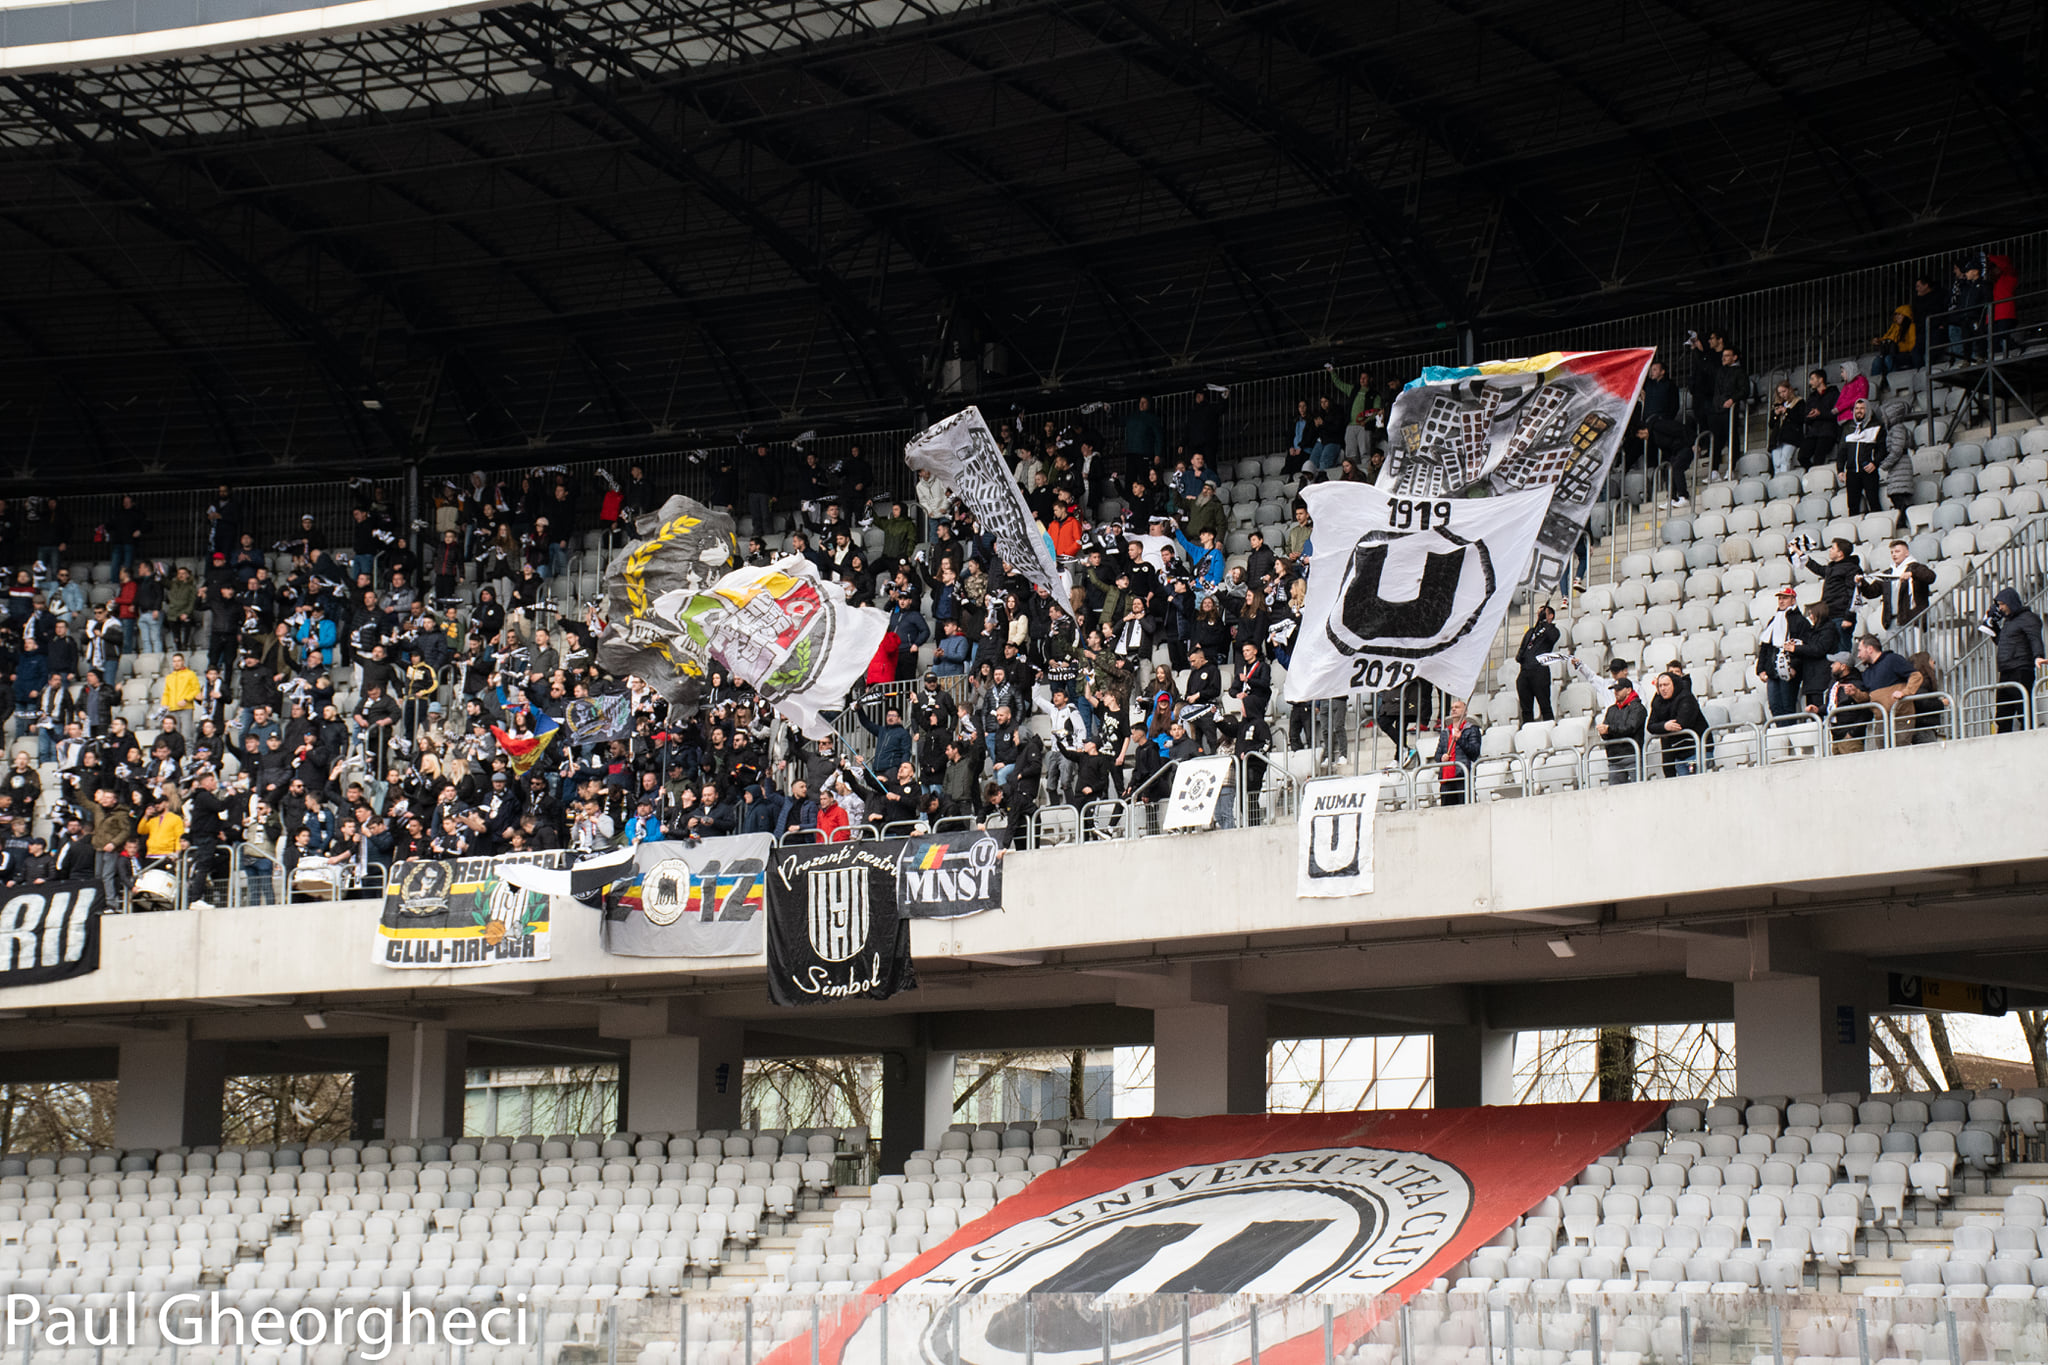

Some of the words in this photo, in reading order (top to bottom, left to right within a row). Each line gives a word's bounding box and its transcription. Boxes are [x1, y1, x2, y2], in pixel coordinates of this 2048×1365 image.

[1386, 498, 1451, 531] 1919
[1342, 545, 1468, 640] U
[1350, 657, 1416, 689] 2019
[1313, 792, 1367, 812] NUMAI
[975, 845, 993, 867] U
[904, 865, 996, 904] MNST
[792, 952, 881, 997] Simbol
[1044, 1154, 1449, 1228] UNIVERSITATEA
[1349, 1211, 1448, 1279] CLUJ
